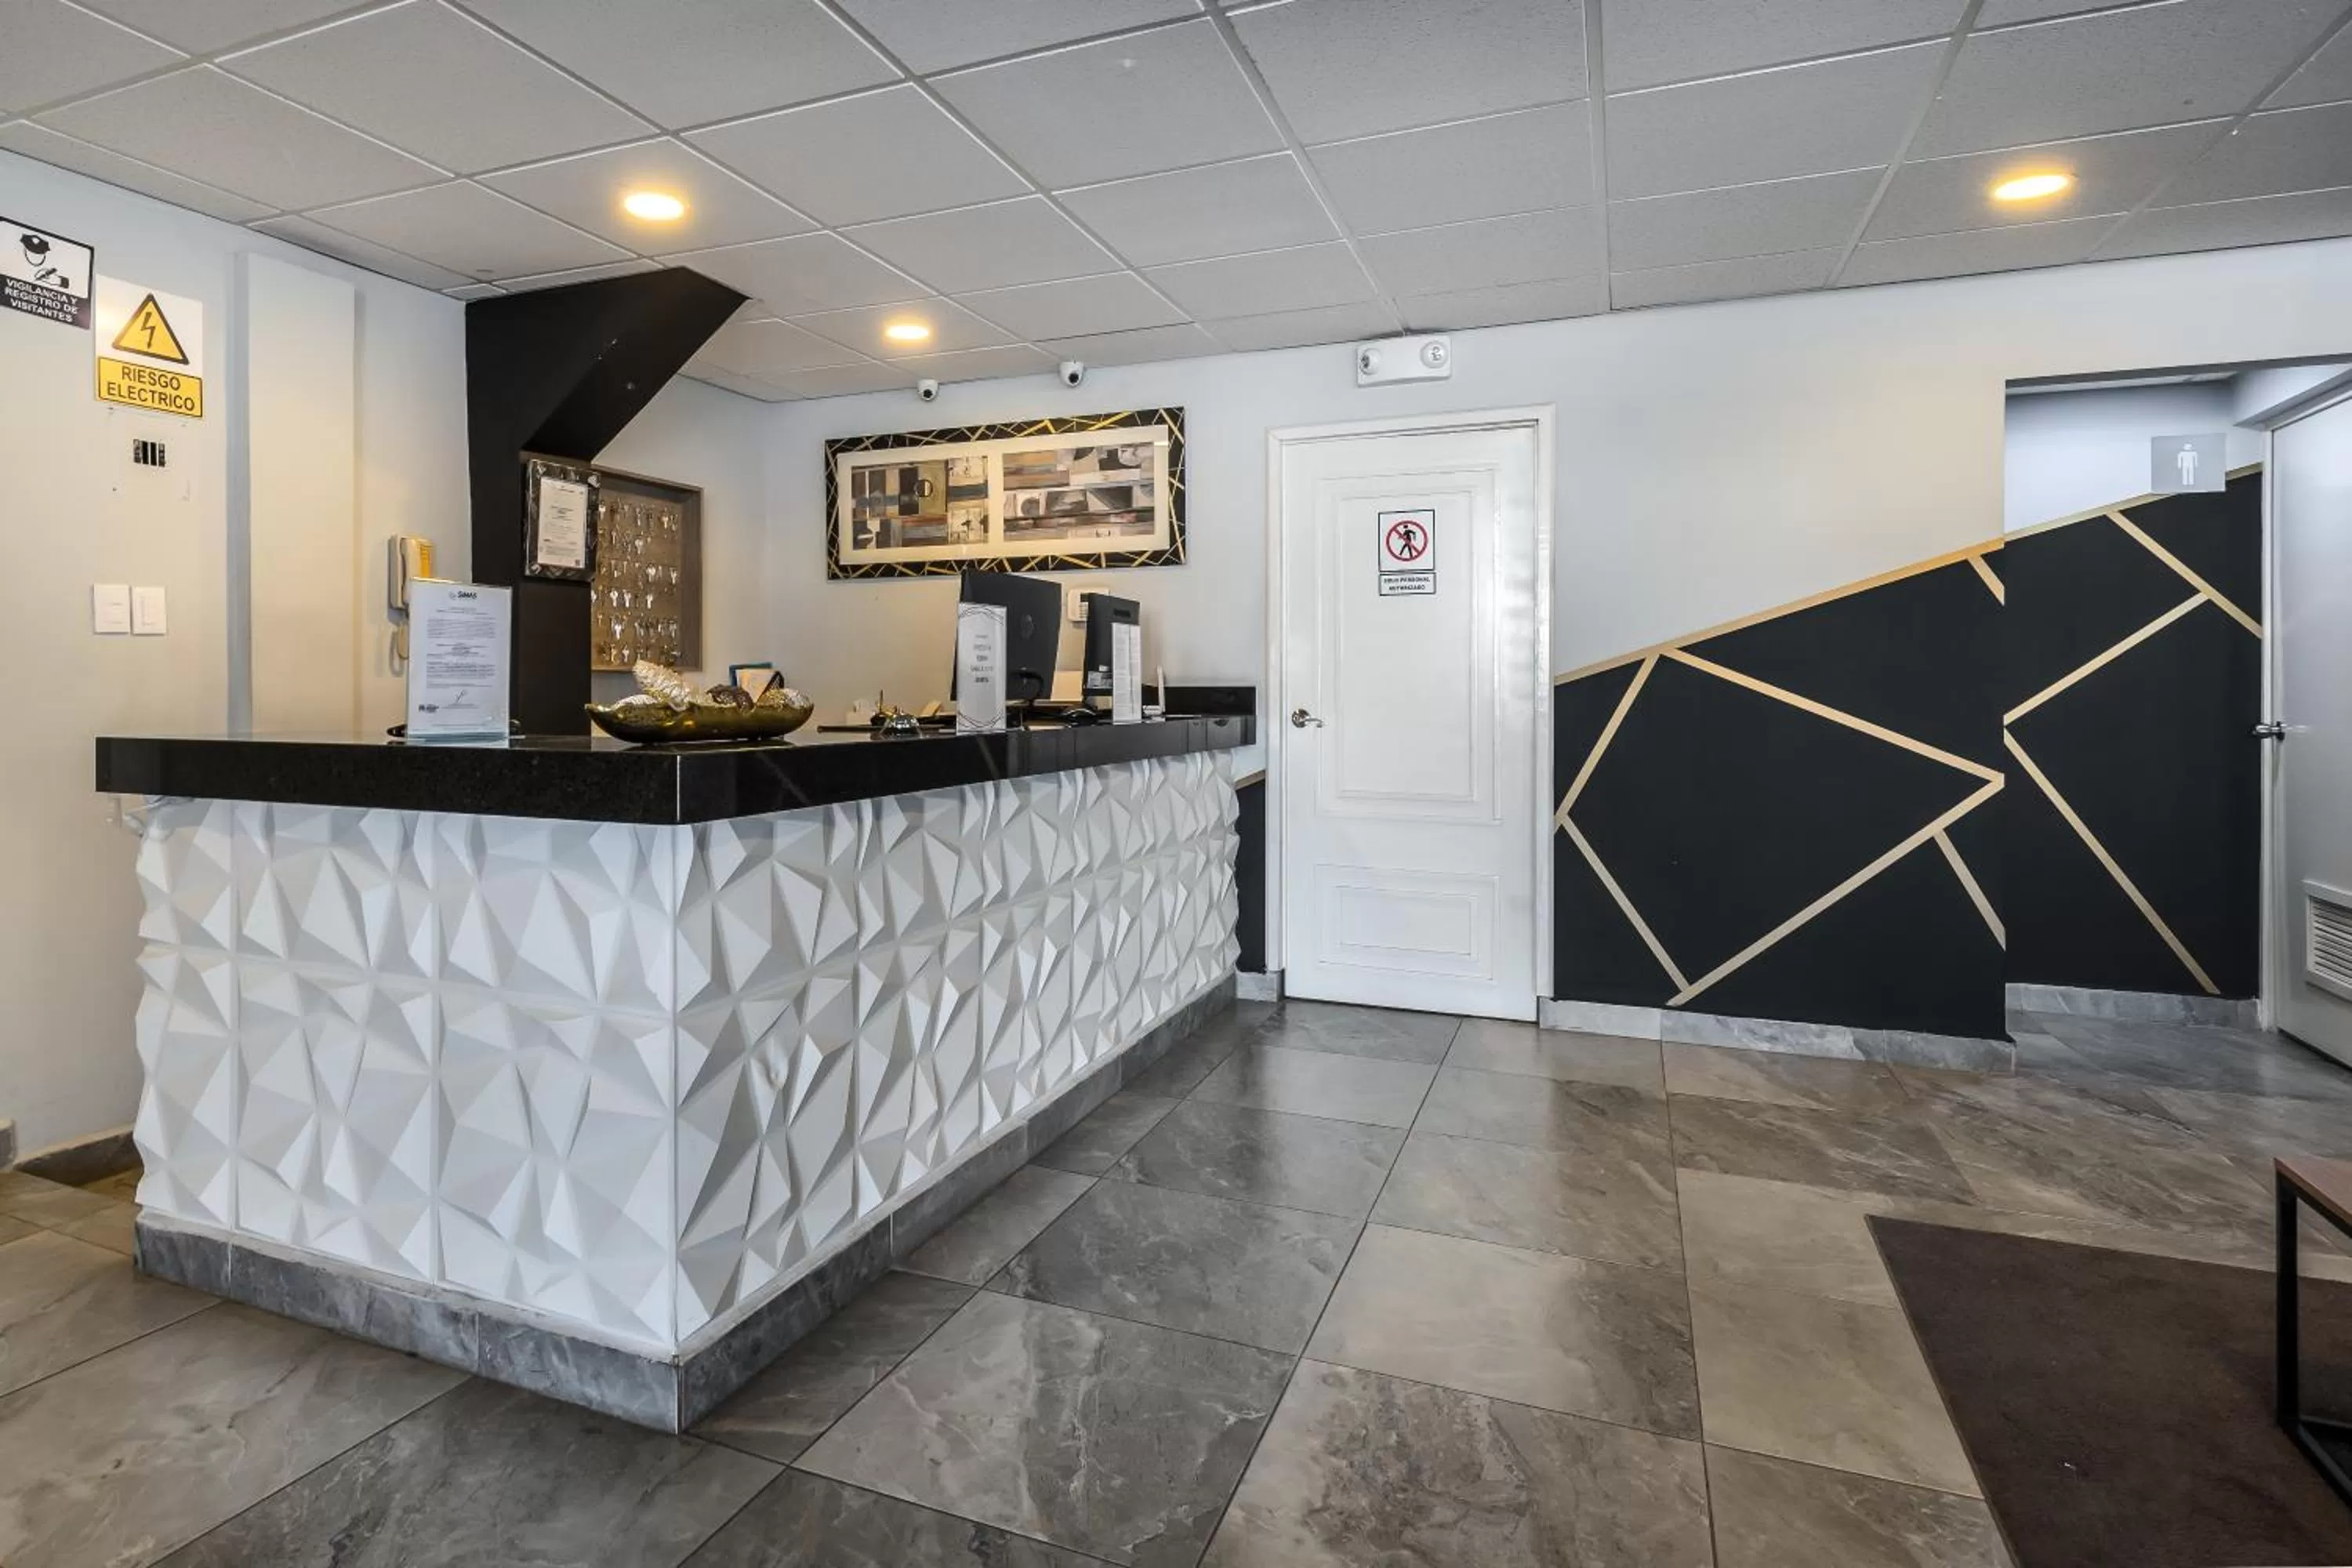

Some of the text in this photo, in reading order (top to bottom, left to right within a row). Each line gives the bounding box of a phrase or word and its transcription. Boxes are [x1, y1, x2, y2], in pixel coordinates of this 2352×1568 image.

[5, 286, 78, 314] REGISTRO DE
[6, 278, 68, 303] VIGILANCIA
[10, 298, 73, 322] VISITANTES
[122, 365, 181, 390] RIESGO
[107, 382, 195, 411] ELECTRICO
